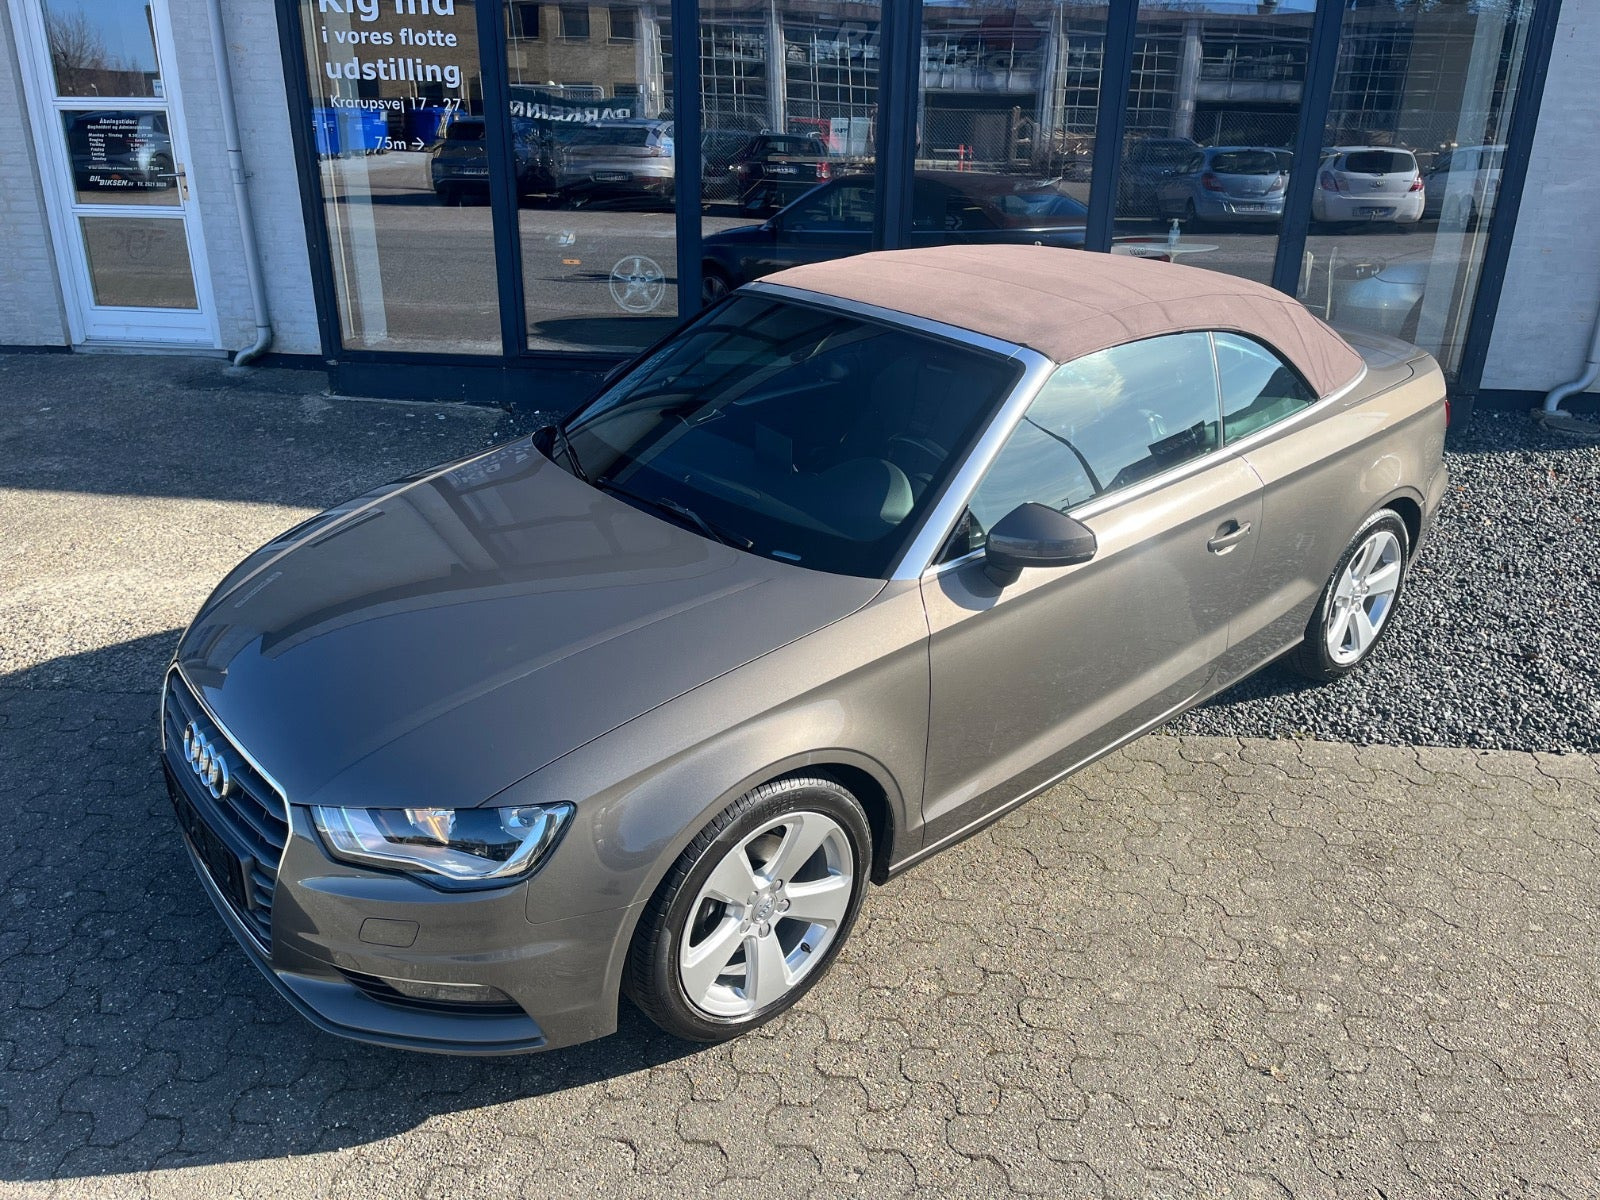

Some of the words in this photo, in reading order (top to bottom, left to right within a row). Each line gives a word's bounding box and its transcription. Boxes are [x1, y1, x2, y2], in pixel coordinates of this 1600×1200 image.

[321, 26, 328, 43] i
[334, 30, 394, 45] vores
[399, 28, 457, 47] flotte
[325, 57, 461, 88] udstilling
[330, 95, 405, 113] Krarupsvej
[410, 97, 427, 110] 17
[443, 98, 461, 111] 27
